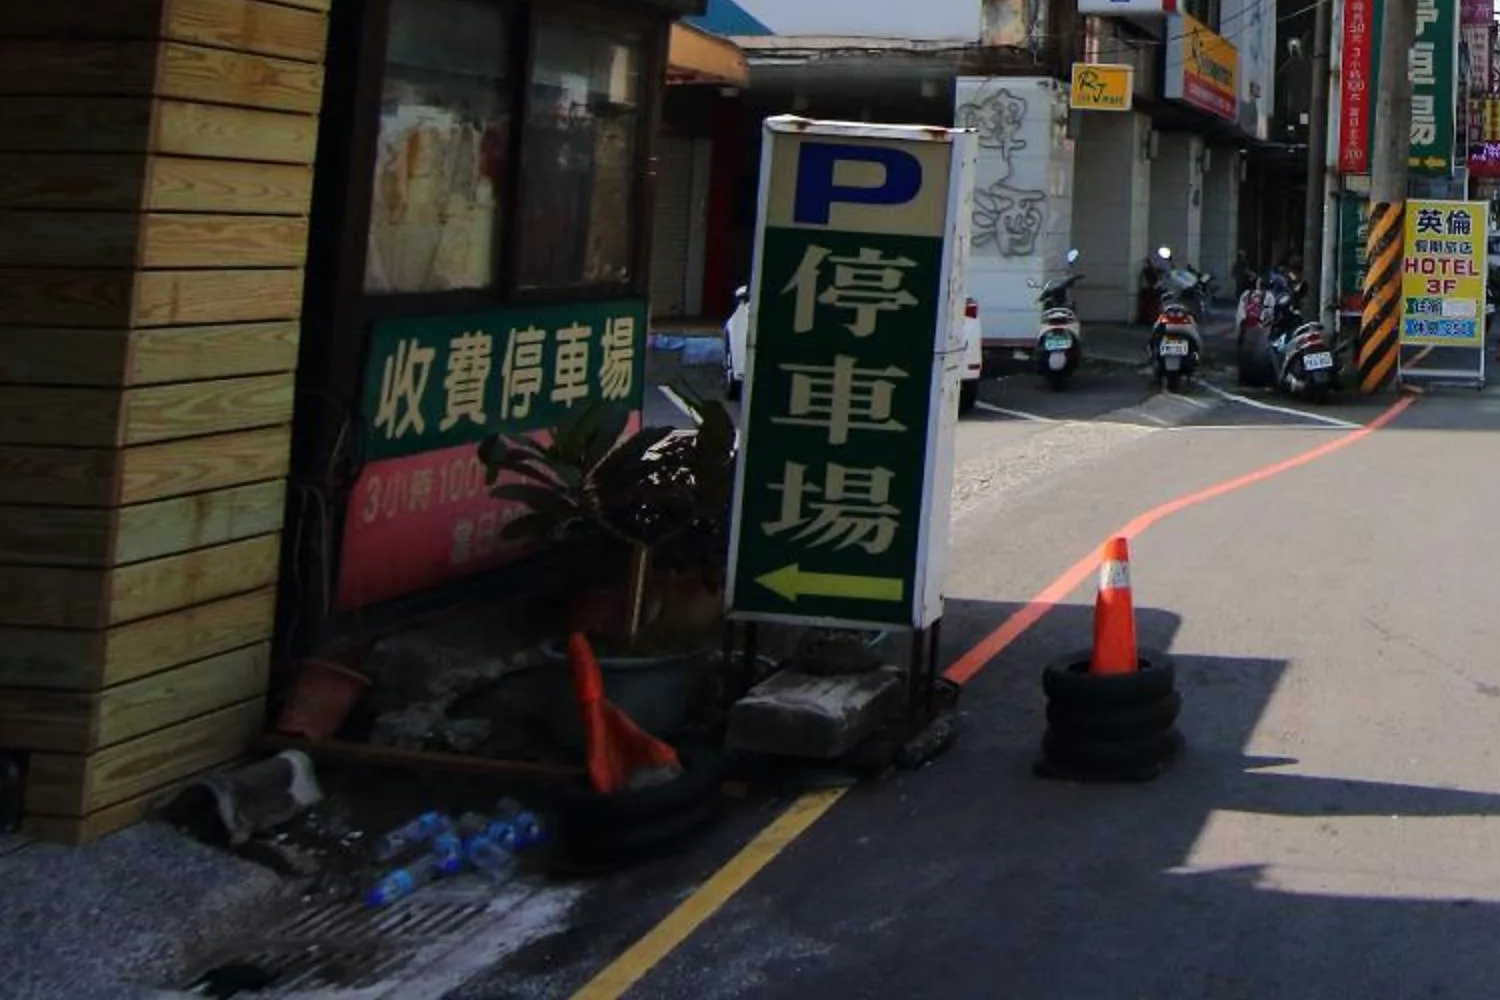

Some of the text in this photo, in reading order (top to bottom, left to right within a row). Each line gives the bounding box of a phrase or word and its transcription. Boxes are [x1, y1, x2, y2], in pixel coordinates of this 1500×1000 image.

[793, 142, 923, 225] P
[1416, 208, 1472, 236] 英倫
[1404, 257, 1479, 276] HOTEL
[1426, 279, 1457, 294] 3F
[373, 315, 636, 441] 收費停車場
[760, 242, 919, 556] 停車場
[362, 454, 487, 525] 3小時100
